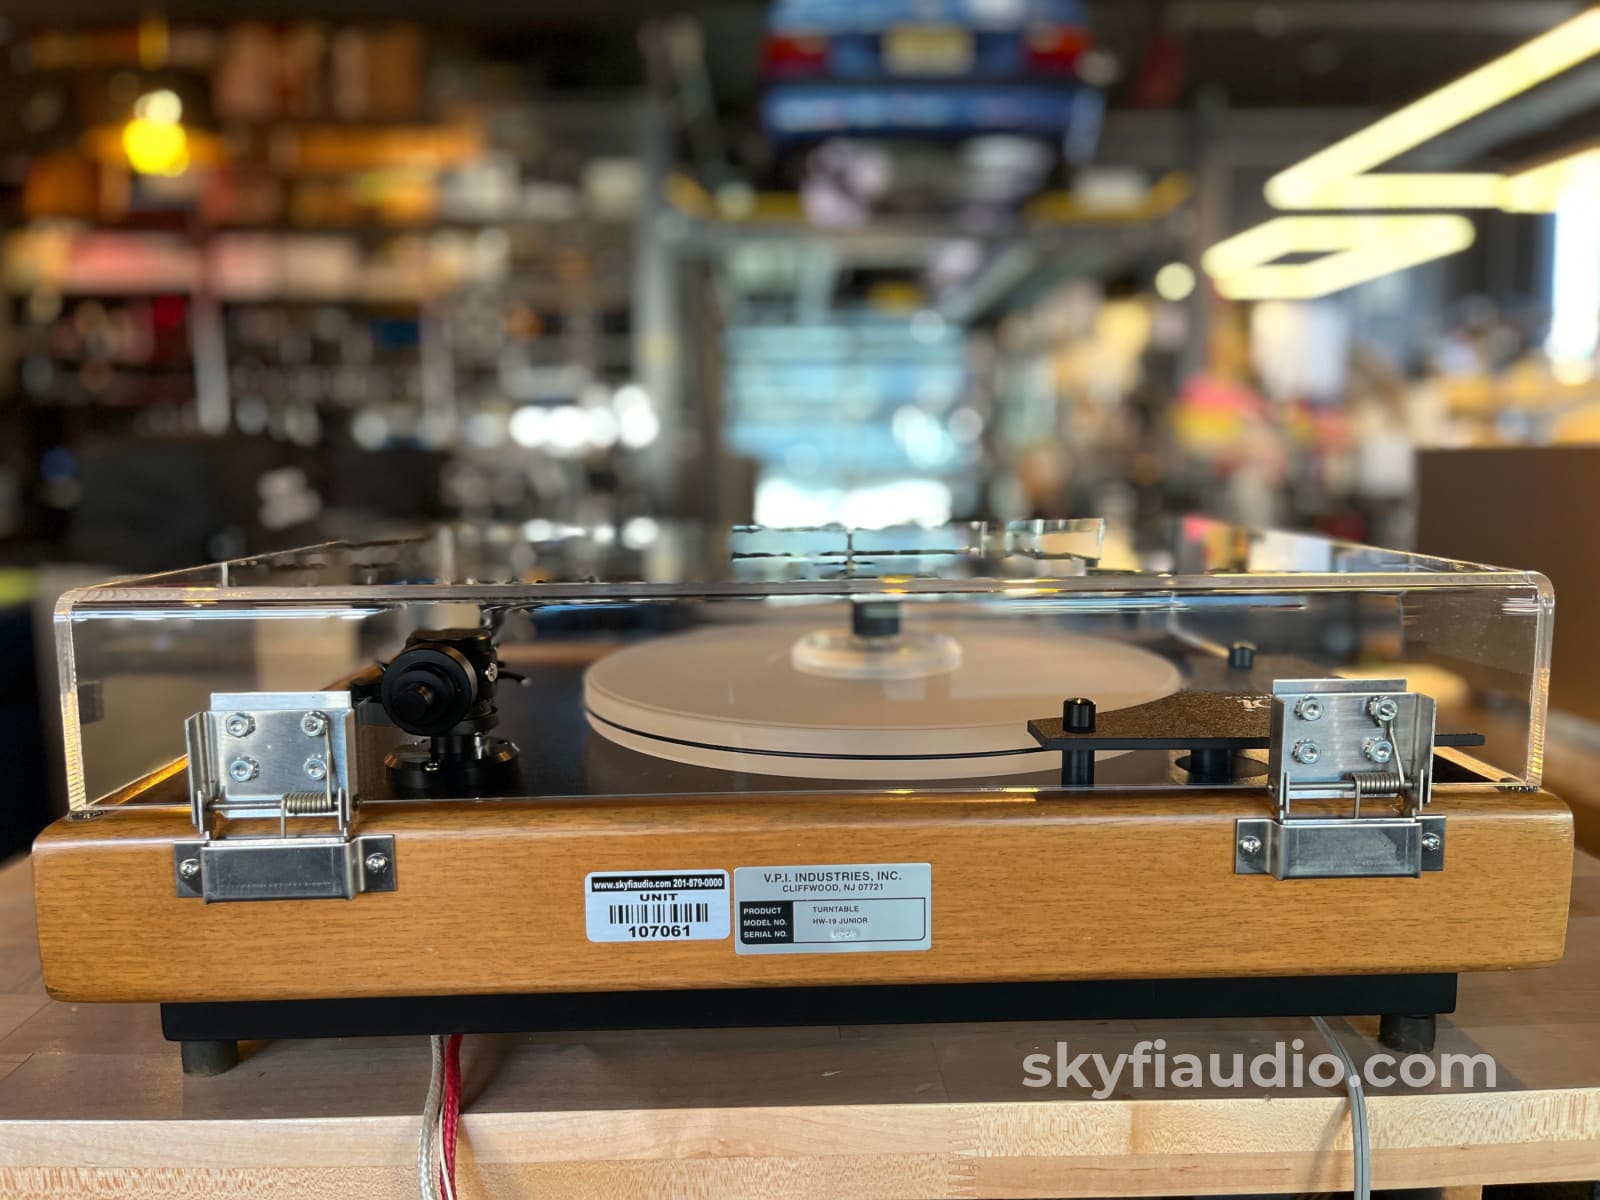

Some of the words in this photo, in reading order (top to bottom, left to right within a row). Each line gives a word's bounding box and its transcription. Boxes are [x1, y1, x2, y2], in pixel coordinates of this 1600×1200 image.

[763, 873, 792, 883] V.P.I.
[795, 871, 874, 883] INDUSTRIES,
[877, 871, 902, 881] INC.
[593, 879, 672, 891] www.skyfiaudio.com
[673, 878, 723, 888] 201-879-0000
[782, 884, 842, 893] CLIFFWOOD,
[843, 883, 856, 892] NJ
[858, 883, 884, 891] 07721
[639, 893, 679, 902] UNIT
[743, 907, 782, 915] PRODUCT
[812, 905, 860, 913] TURNTABLE
[773, 918, 787, 926] NO.
[812, 917, 837, 925] HW-19
[838, 917, 869, 925] JUNIOR
[628, 925, 691, 938] 107061
[774, 930, 788, 938] NO.
